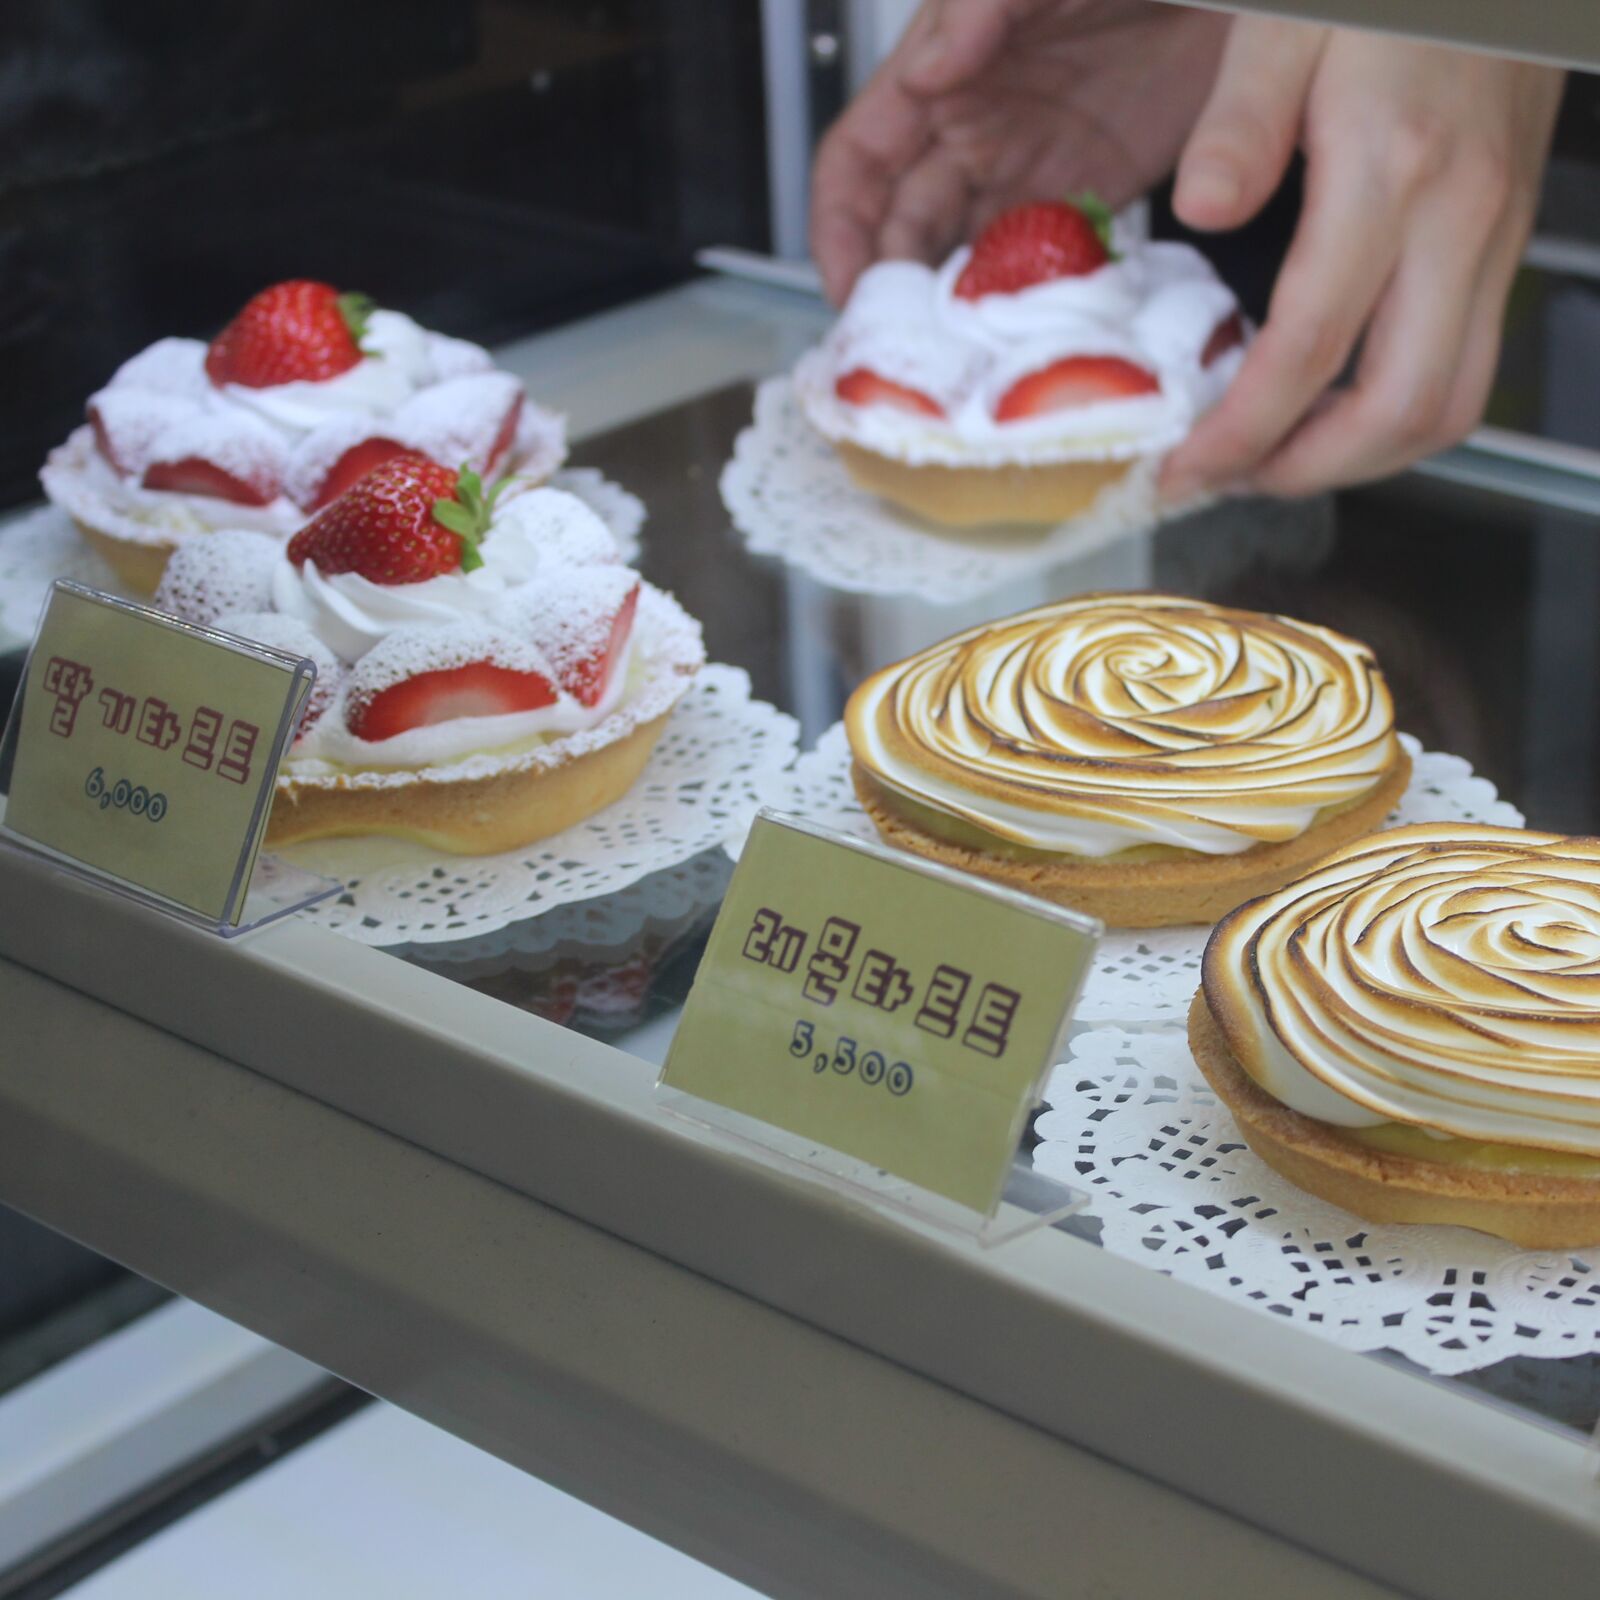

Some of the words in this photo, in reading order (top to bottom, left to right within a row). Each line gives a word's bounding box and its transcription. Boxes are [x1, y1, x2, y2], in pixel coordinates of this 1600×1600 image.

[43, 656, 259, 785] 딸기타르트
[85, 767, 168, 823] 6,000
[741, 907, 1022, 1059] 레몬타르트
[789, 1020, 913, 1097] 5,500
